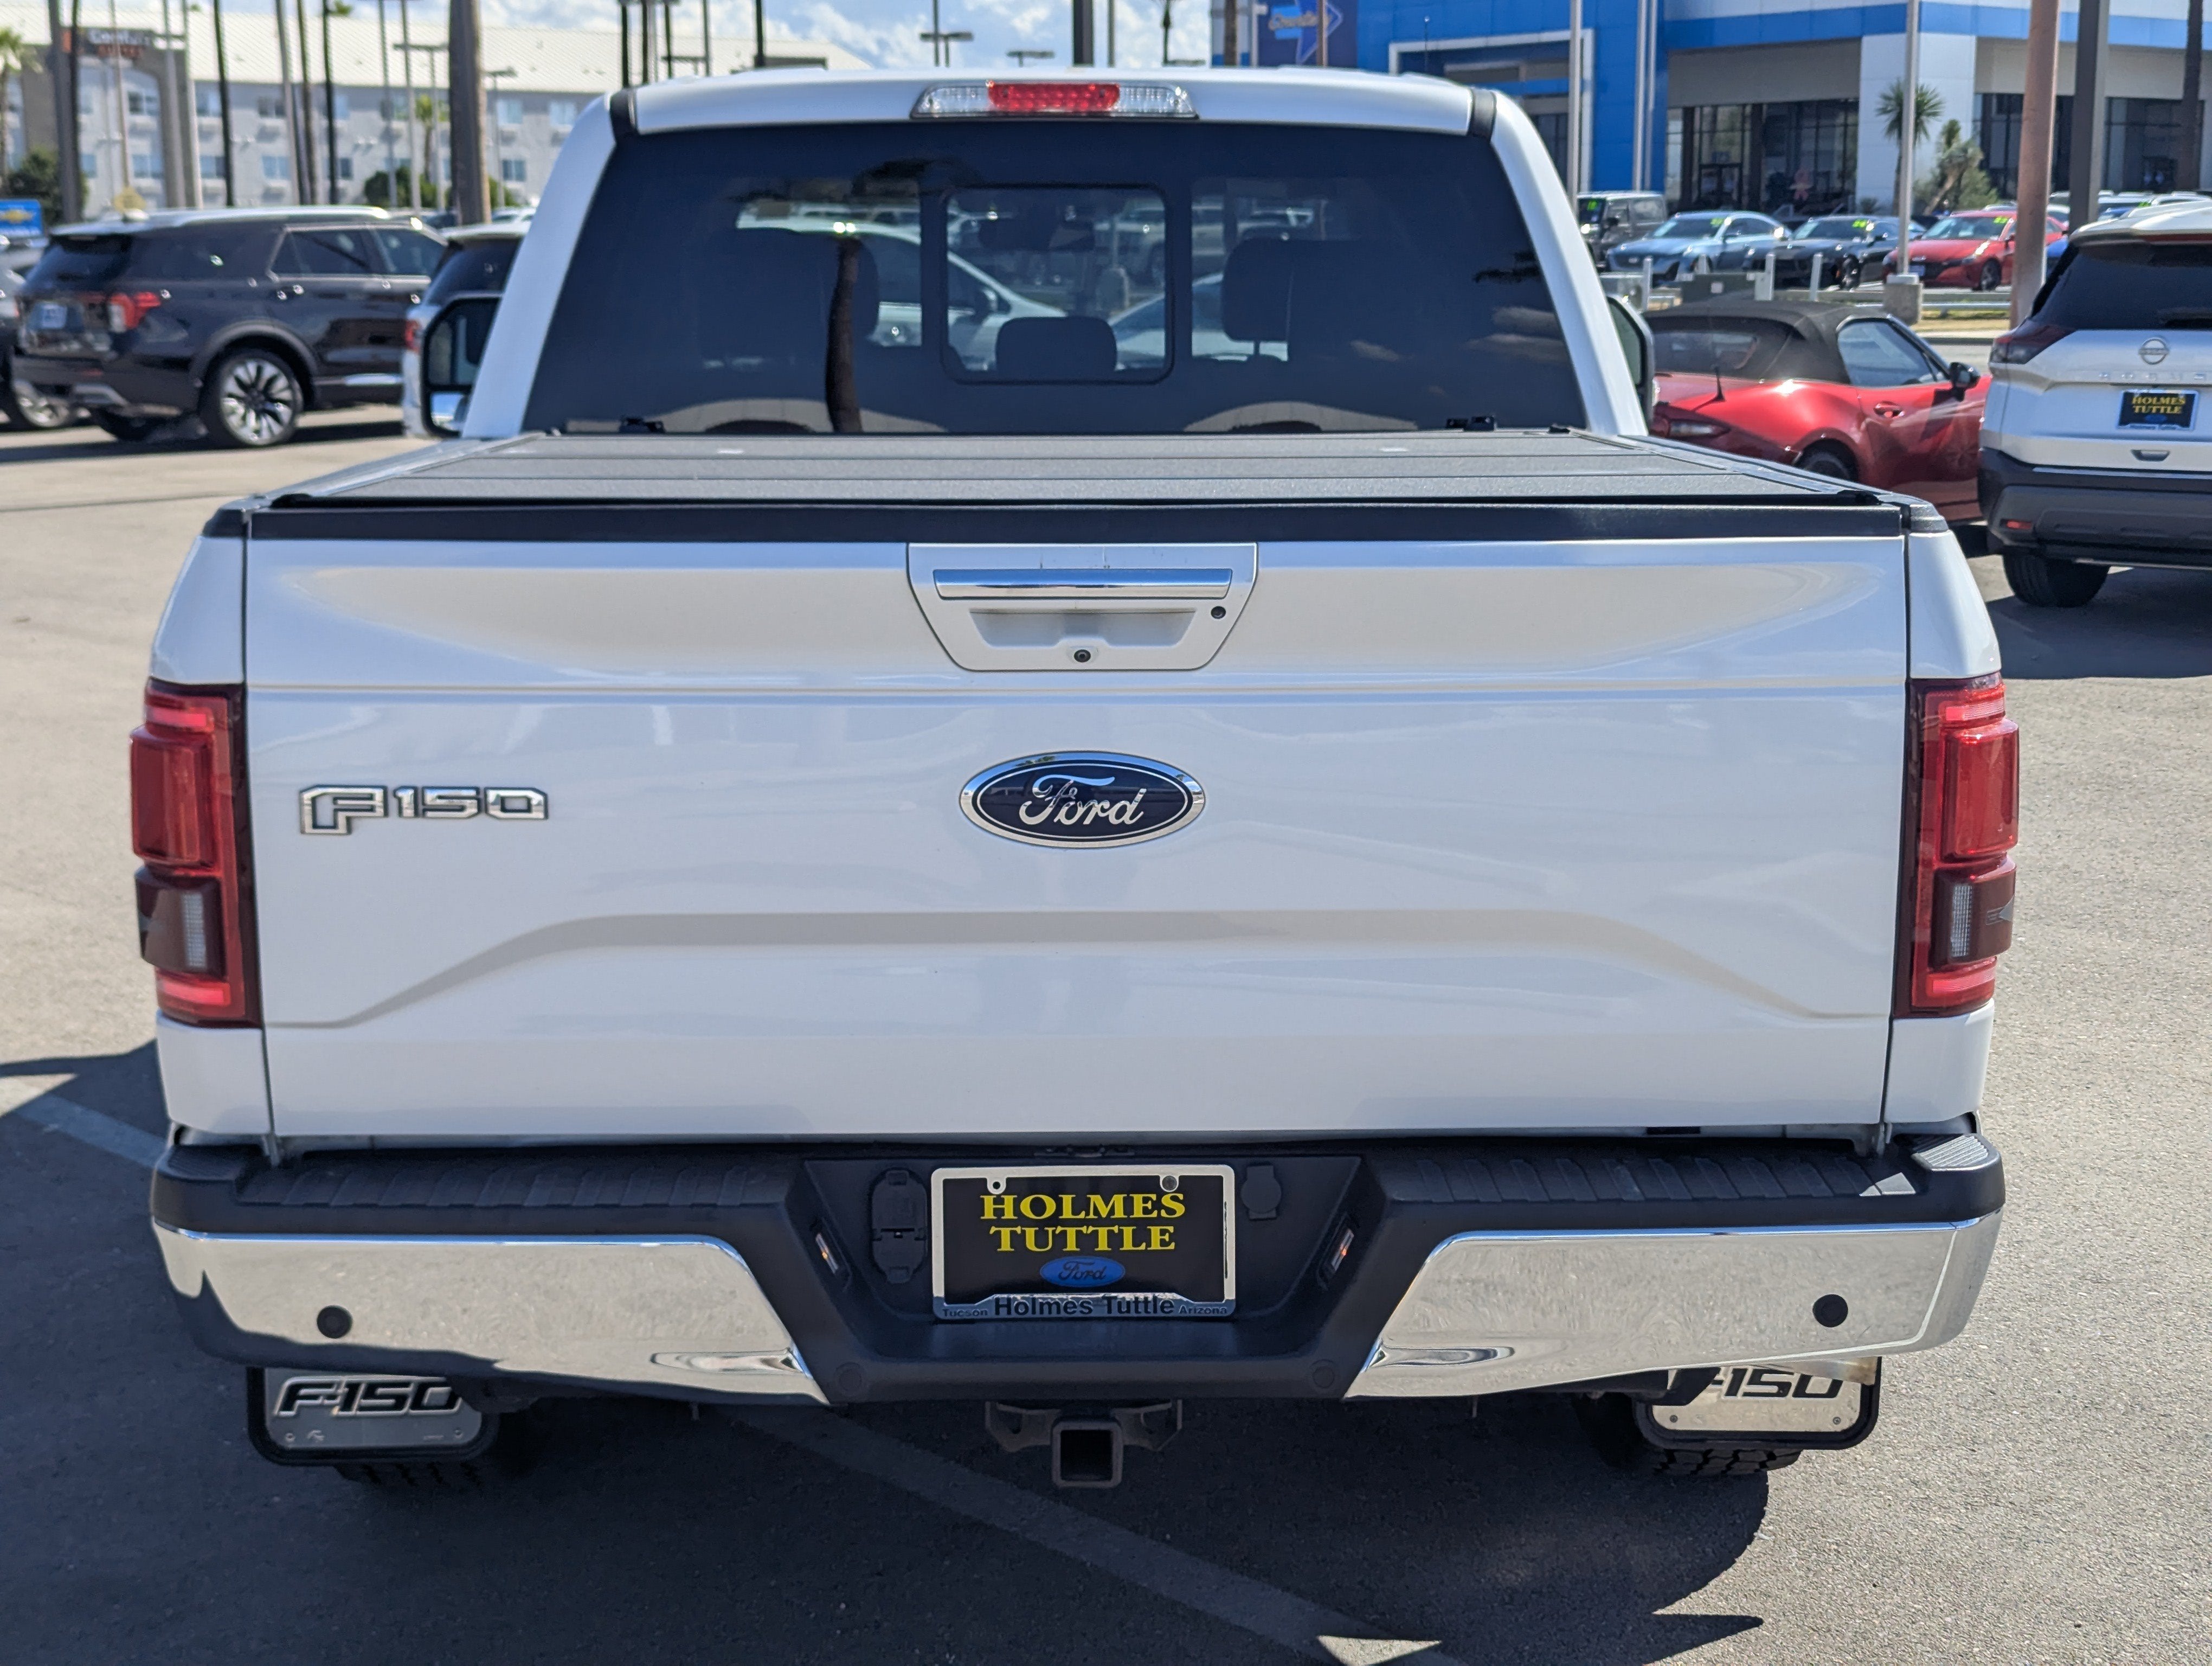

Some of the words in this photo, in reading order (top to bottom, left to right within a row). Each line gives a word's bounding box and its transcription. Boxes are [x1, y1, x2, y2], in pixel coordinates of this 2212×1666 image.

[2132, 396, 2186, 405] HOLMES
[2132, 406, 2183, 414] TUTTLE
[1019, 774, 1147, 825] Ford
[979, 1193, 1186, 1220] HOLMES
[989, 1225, 1176, 1252] TUTTLE
[1058, 1261, 1108, 1282] Ford
[942, 1308, 988, 1318] Tucson
[994, 1296, 1094, 1316] Holmes
[1102, 1295, 1175, 1315] Tuttle
[1178, 1305, 1228, 1316] Arizona
